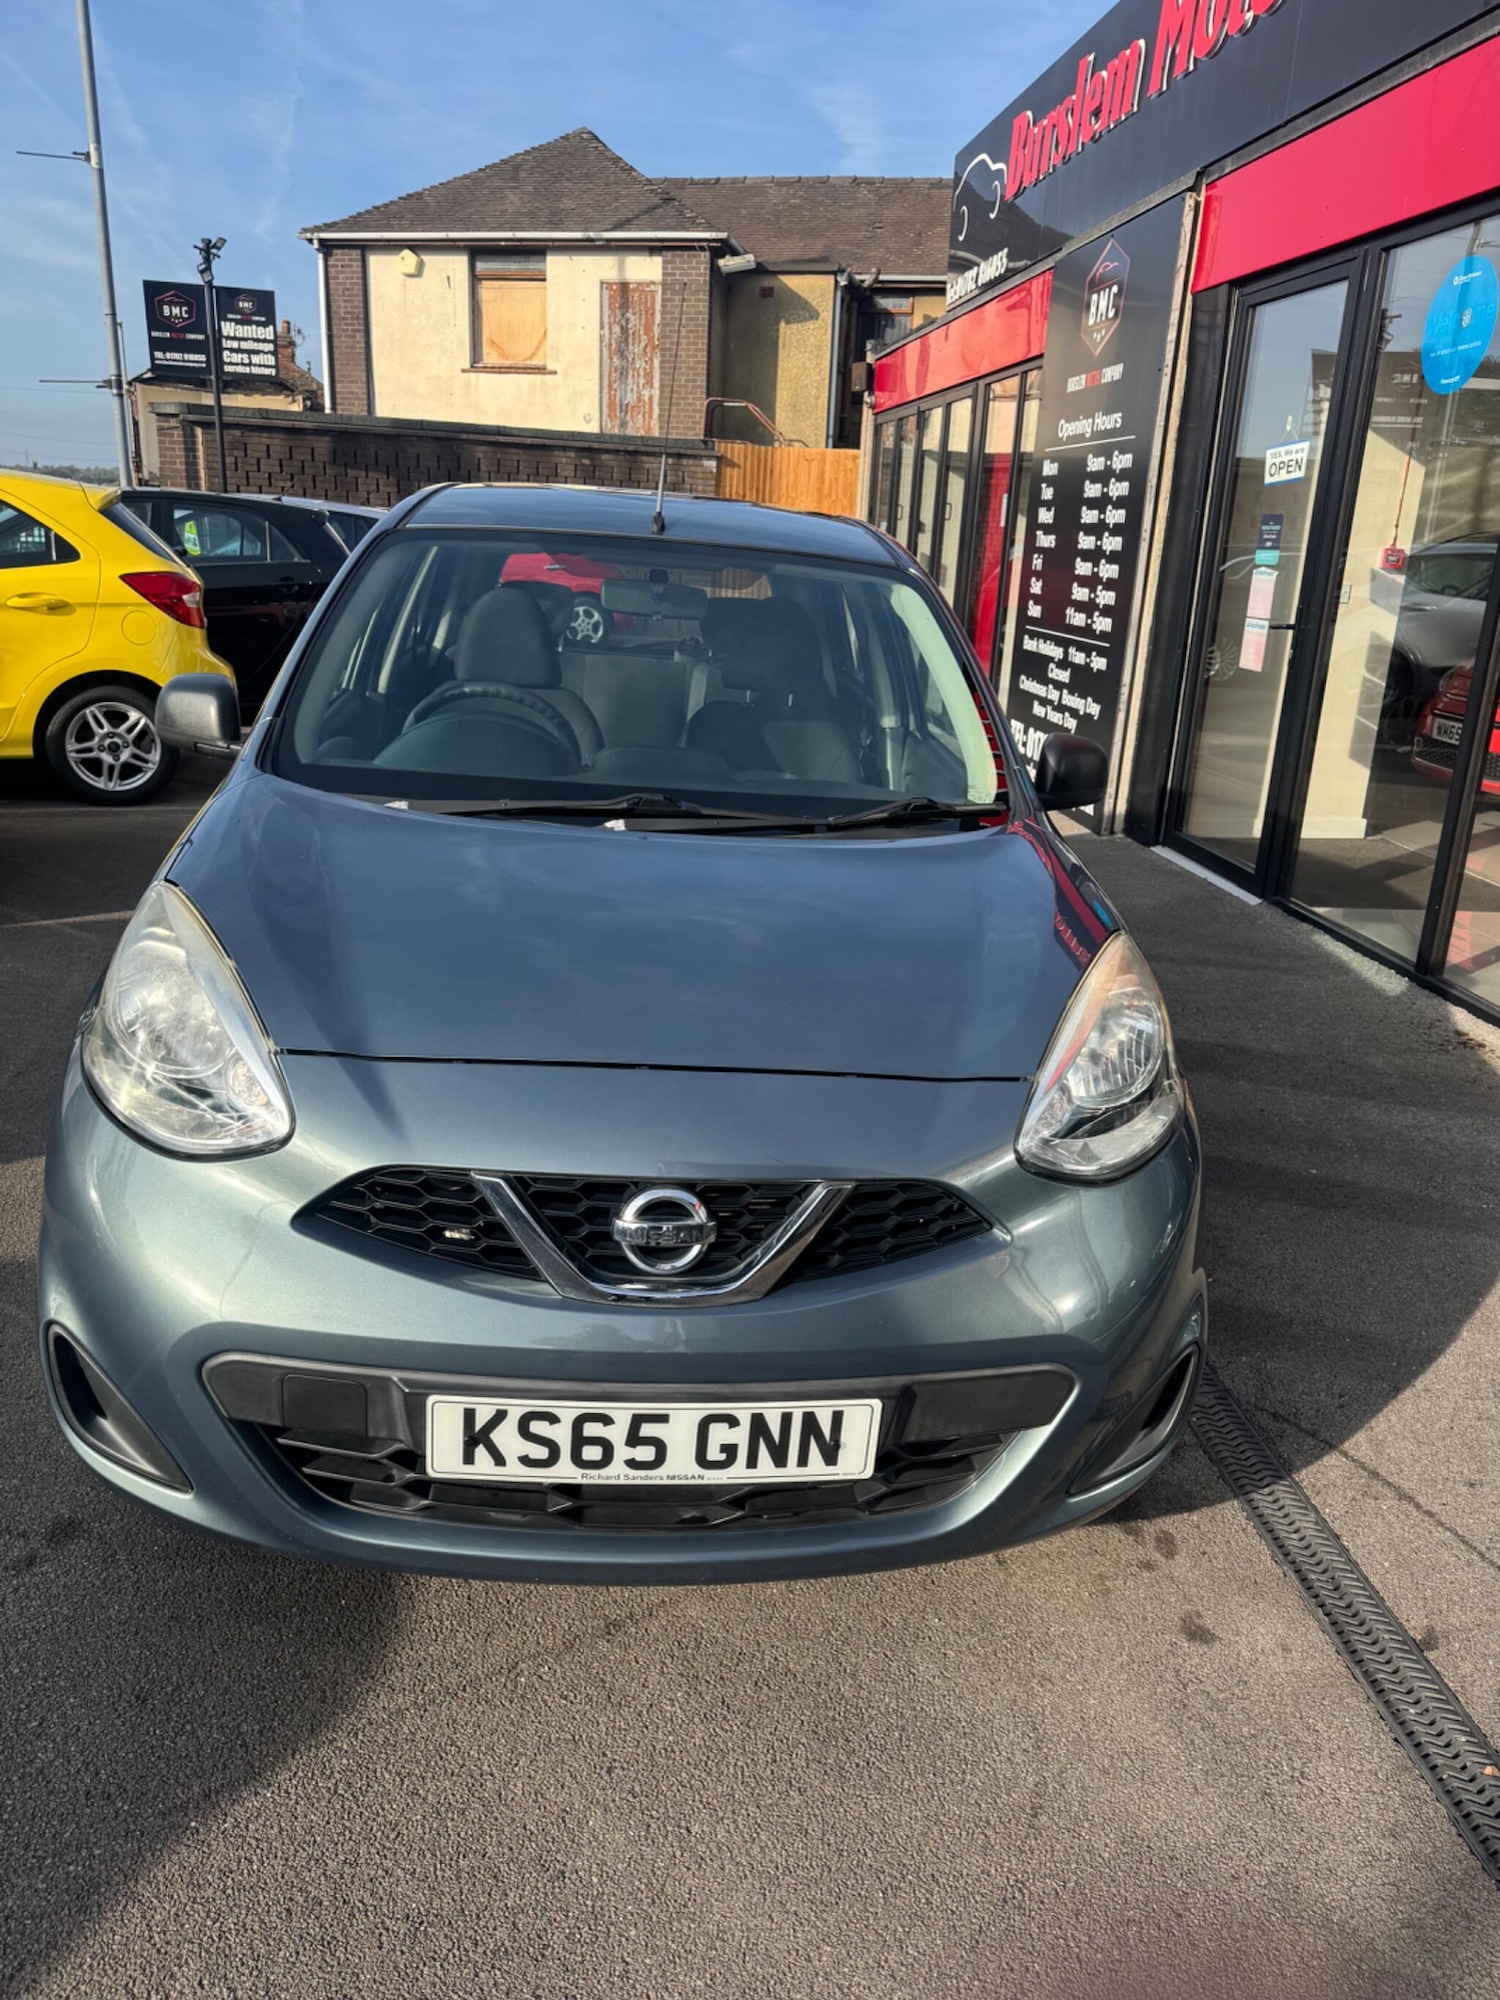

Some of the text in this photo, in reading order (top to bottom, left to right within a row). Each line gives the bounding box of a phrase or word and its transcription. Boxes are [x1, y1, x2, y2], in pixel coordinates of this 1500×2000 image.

[1003, 38, 1146, 201] Burslem
[163, 305, 189, 318] BMC
[239, 300, 253, 309] BMC
[1088, 284, 1119, 326] BMC
[220, 320, 275, 341] Wanted
[222, 338, 275, 353] Low mileage
[222, 350, 250, 364] Cars
[250, 352, 276, 367] with
[250, 365, 277, 377] history
[1058, 410, 1122, 442] Opening Hours
[1042, 459, 1059, 476] Mon
[1086, 453, 1105, 472] 9am
[1112, 450, 1133, 474] 6pm
[1268, 457, 1304, 478] OPEN
[1041, 483, 1054, 500] Tue
[1083, 480, 1102, 498] 9am
[1108, 477, 1130, 501] 6pm
[1038, 507, 1055, 524] Wed
[1080, 505, 1099, 524] 9am
[1105, 504, 1126, 528] 6pm
[1036, 531, 1056, 548] Thurs
[1077, 531, 1096, 549] 9am
[1102, 531, 1122, 555] 6pm
[1032, 553, 1043, 571] Fri
[1074, 557, 1093, 576] 9am
[1099, 558, 1119, 582] 6pm
[1029, 576, 1042, 595] Sat
[1071, 581, 1090, 602] 9am
[1095, 585, 1116, 609] 5pm
[1027, 599, 1041, 618] Sun
[1065, 606, 1086, 627] 11am
[1092, 611, 1113, 635] 5pm
[1023, 634, 1038, 652] Bank
[1038, 639, 1064, 662] Holidays
[1068, 646, 1085, 665] 11am
[1090, 651, 1107, 672] 5pm
[1048, 663, 1071, 684] Closed
[1019, 674, 1101, 720] Christmas Day Boxing Day
[1032, 700, 1078, 735] New Years Day
[625, 1225, 704, 1245] NISSAN
[462, 1407, 845, 1471] KS65 GNN
[580, 1472, 620, 1482] Richard
[623, 1473, 664, 1482] Sanders
[666, 1473, 705, 1481] NISSAN
